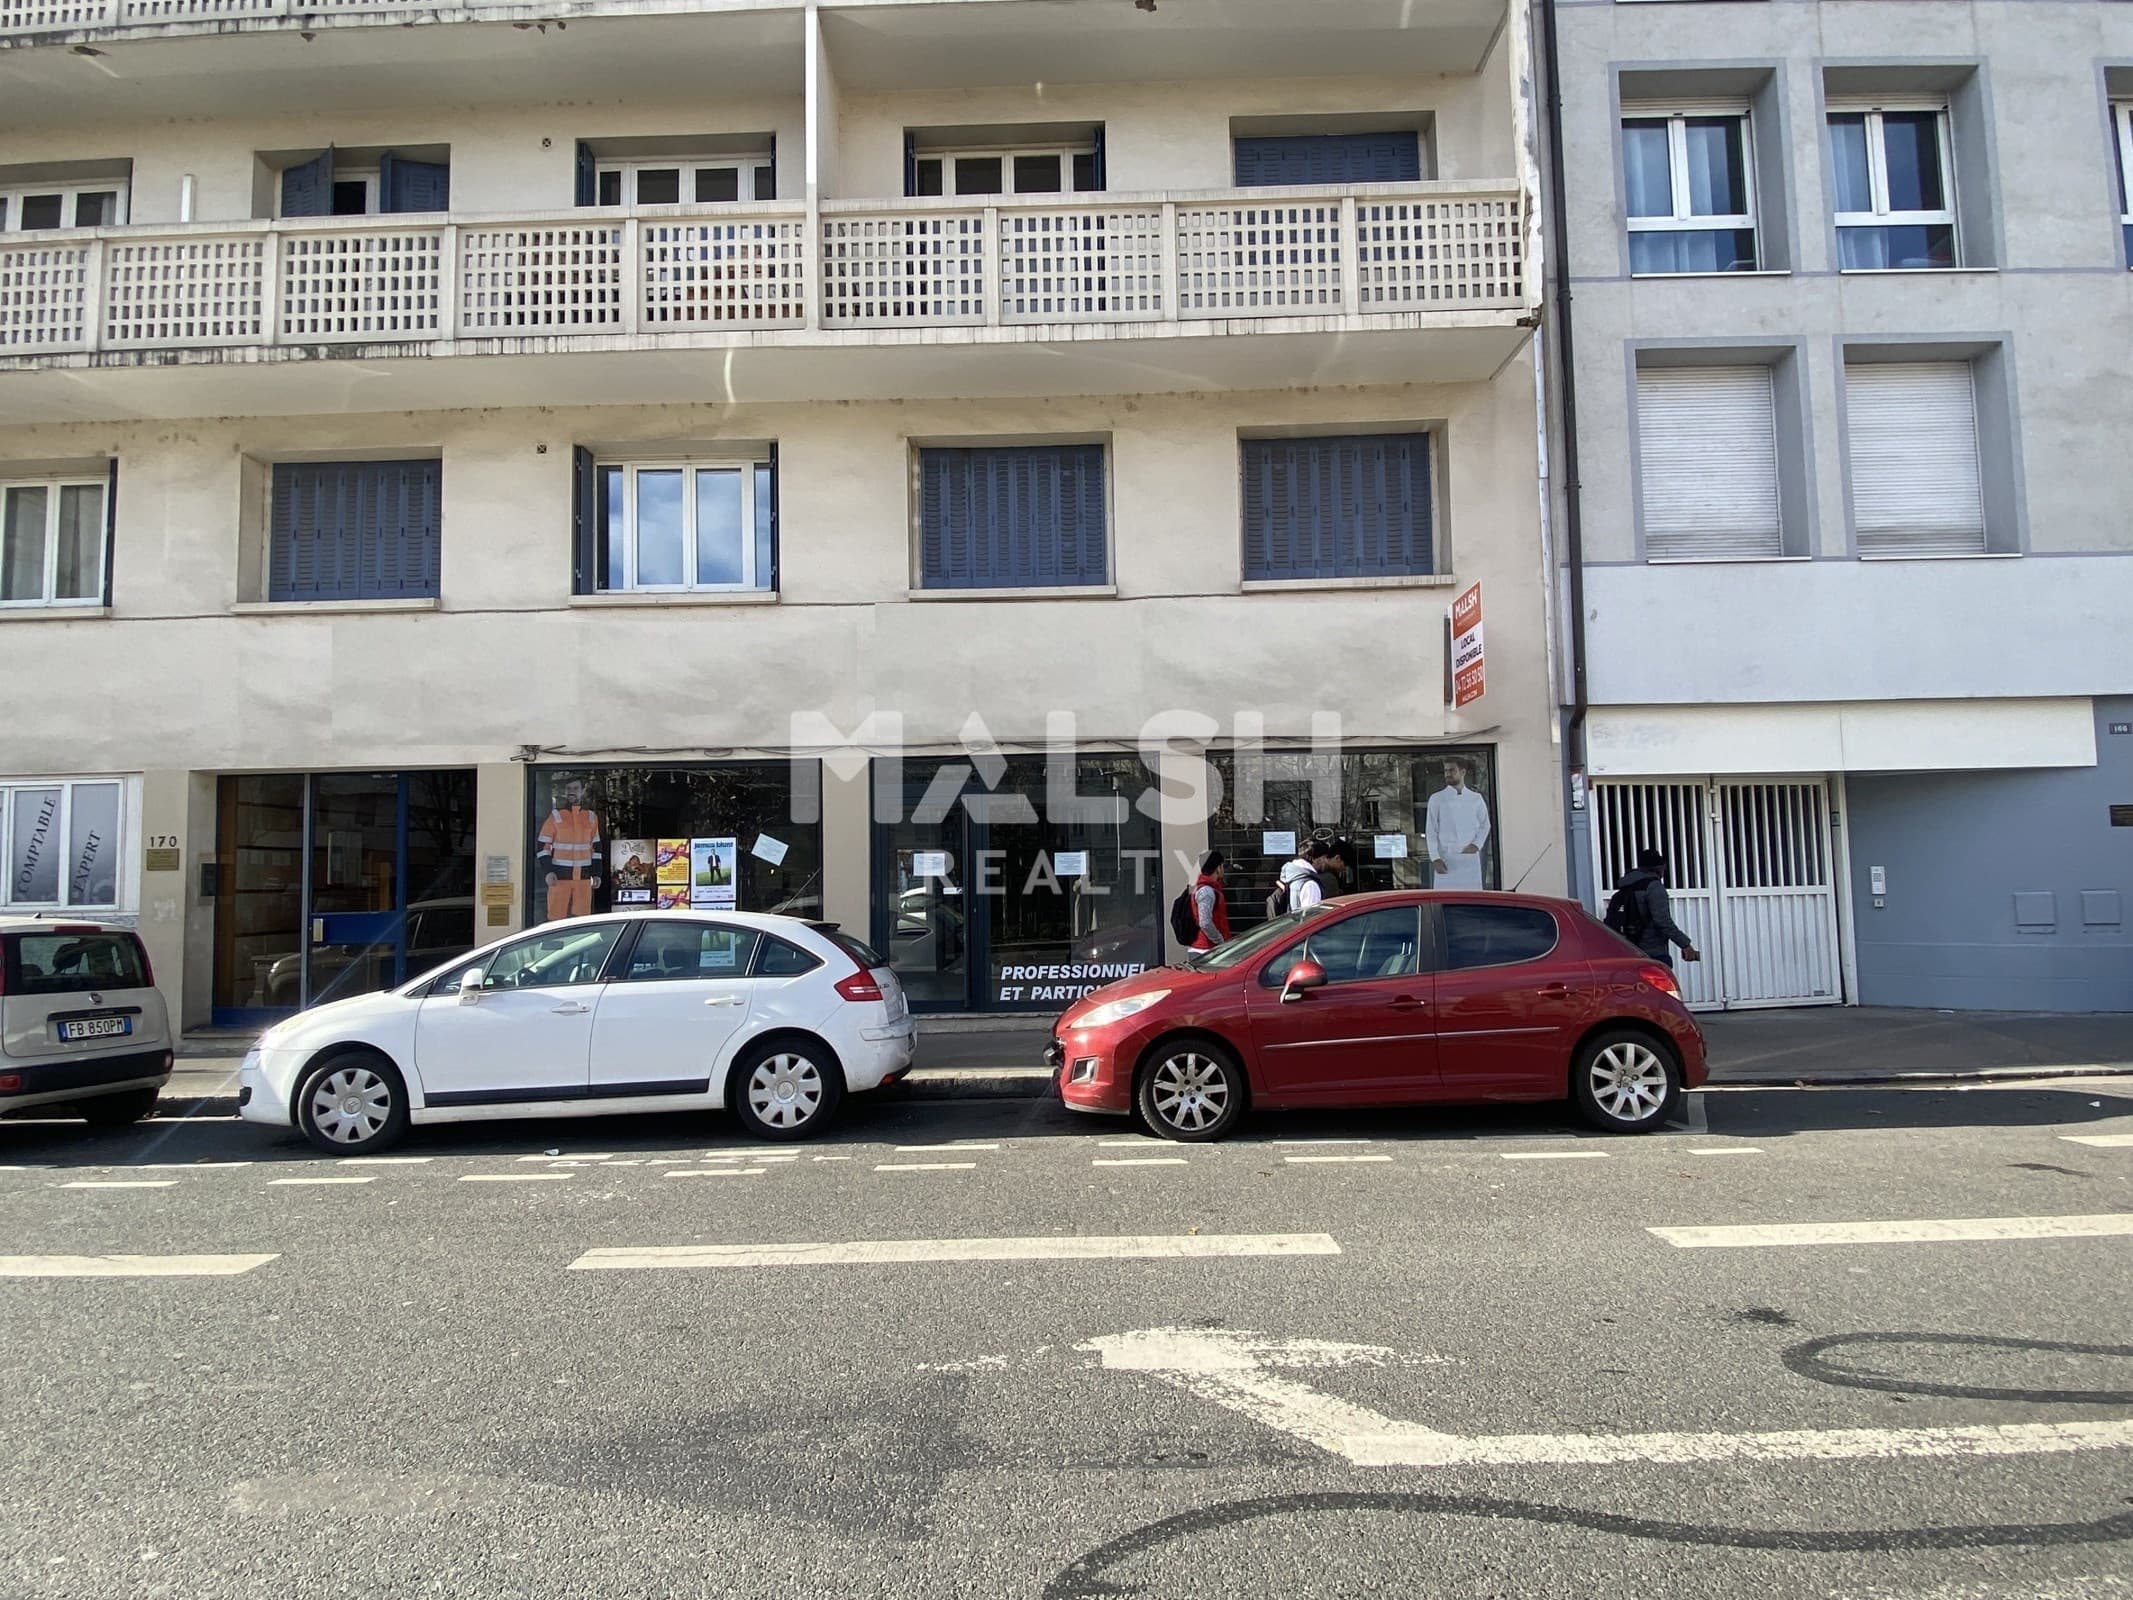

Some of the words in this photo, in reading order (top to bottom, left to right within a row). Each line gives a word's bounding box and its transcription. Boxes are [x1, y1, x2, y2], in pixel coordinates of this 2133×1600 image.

[1460, 632, 1475, 650] LOCAL
[1455, 643, 1482, 669] DISPONIBLE
[17, 795, 56, 894] COMPTABLE
[150, 836, 177, 848] 170
[73, 829, 102, 894] EXPERT
[1000, 986, 1023, 1001] ET
[1031, 985, 1101, 1001] PARTIC
[68, 1023, 84, 1037] FB
